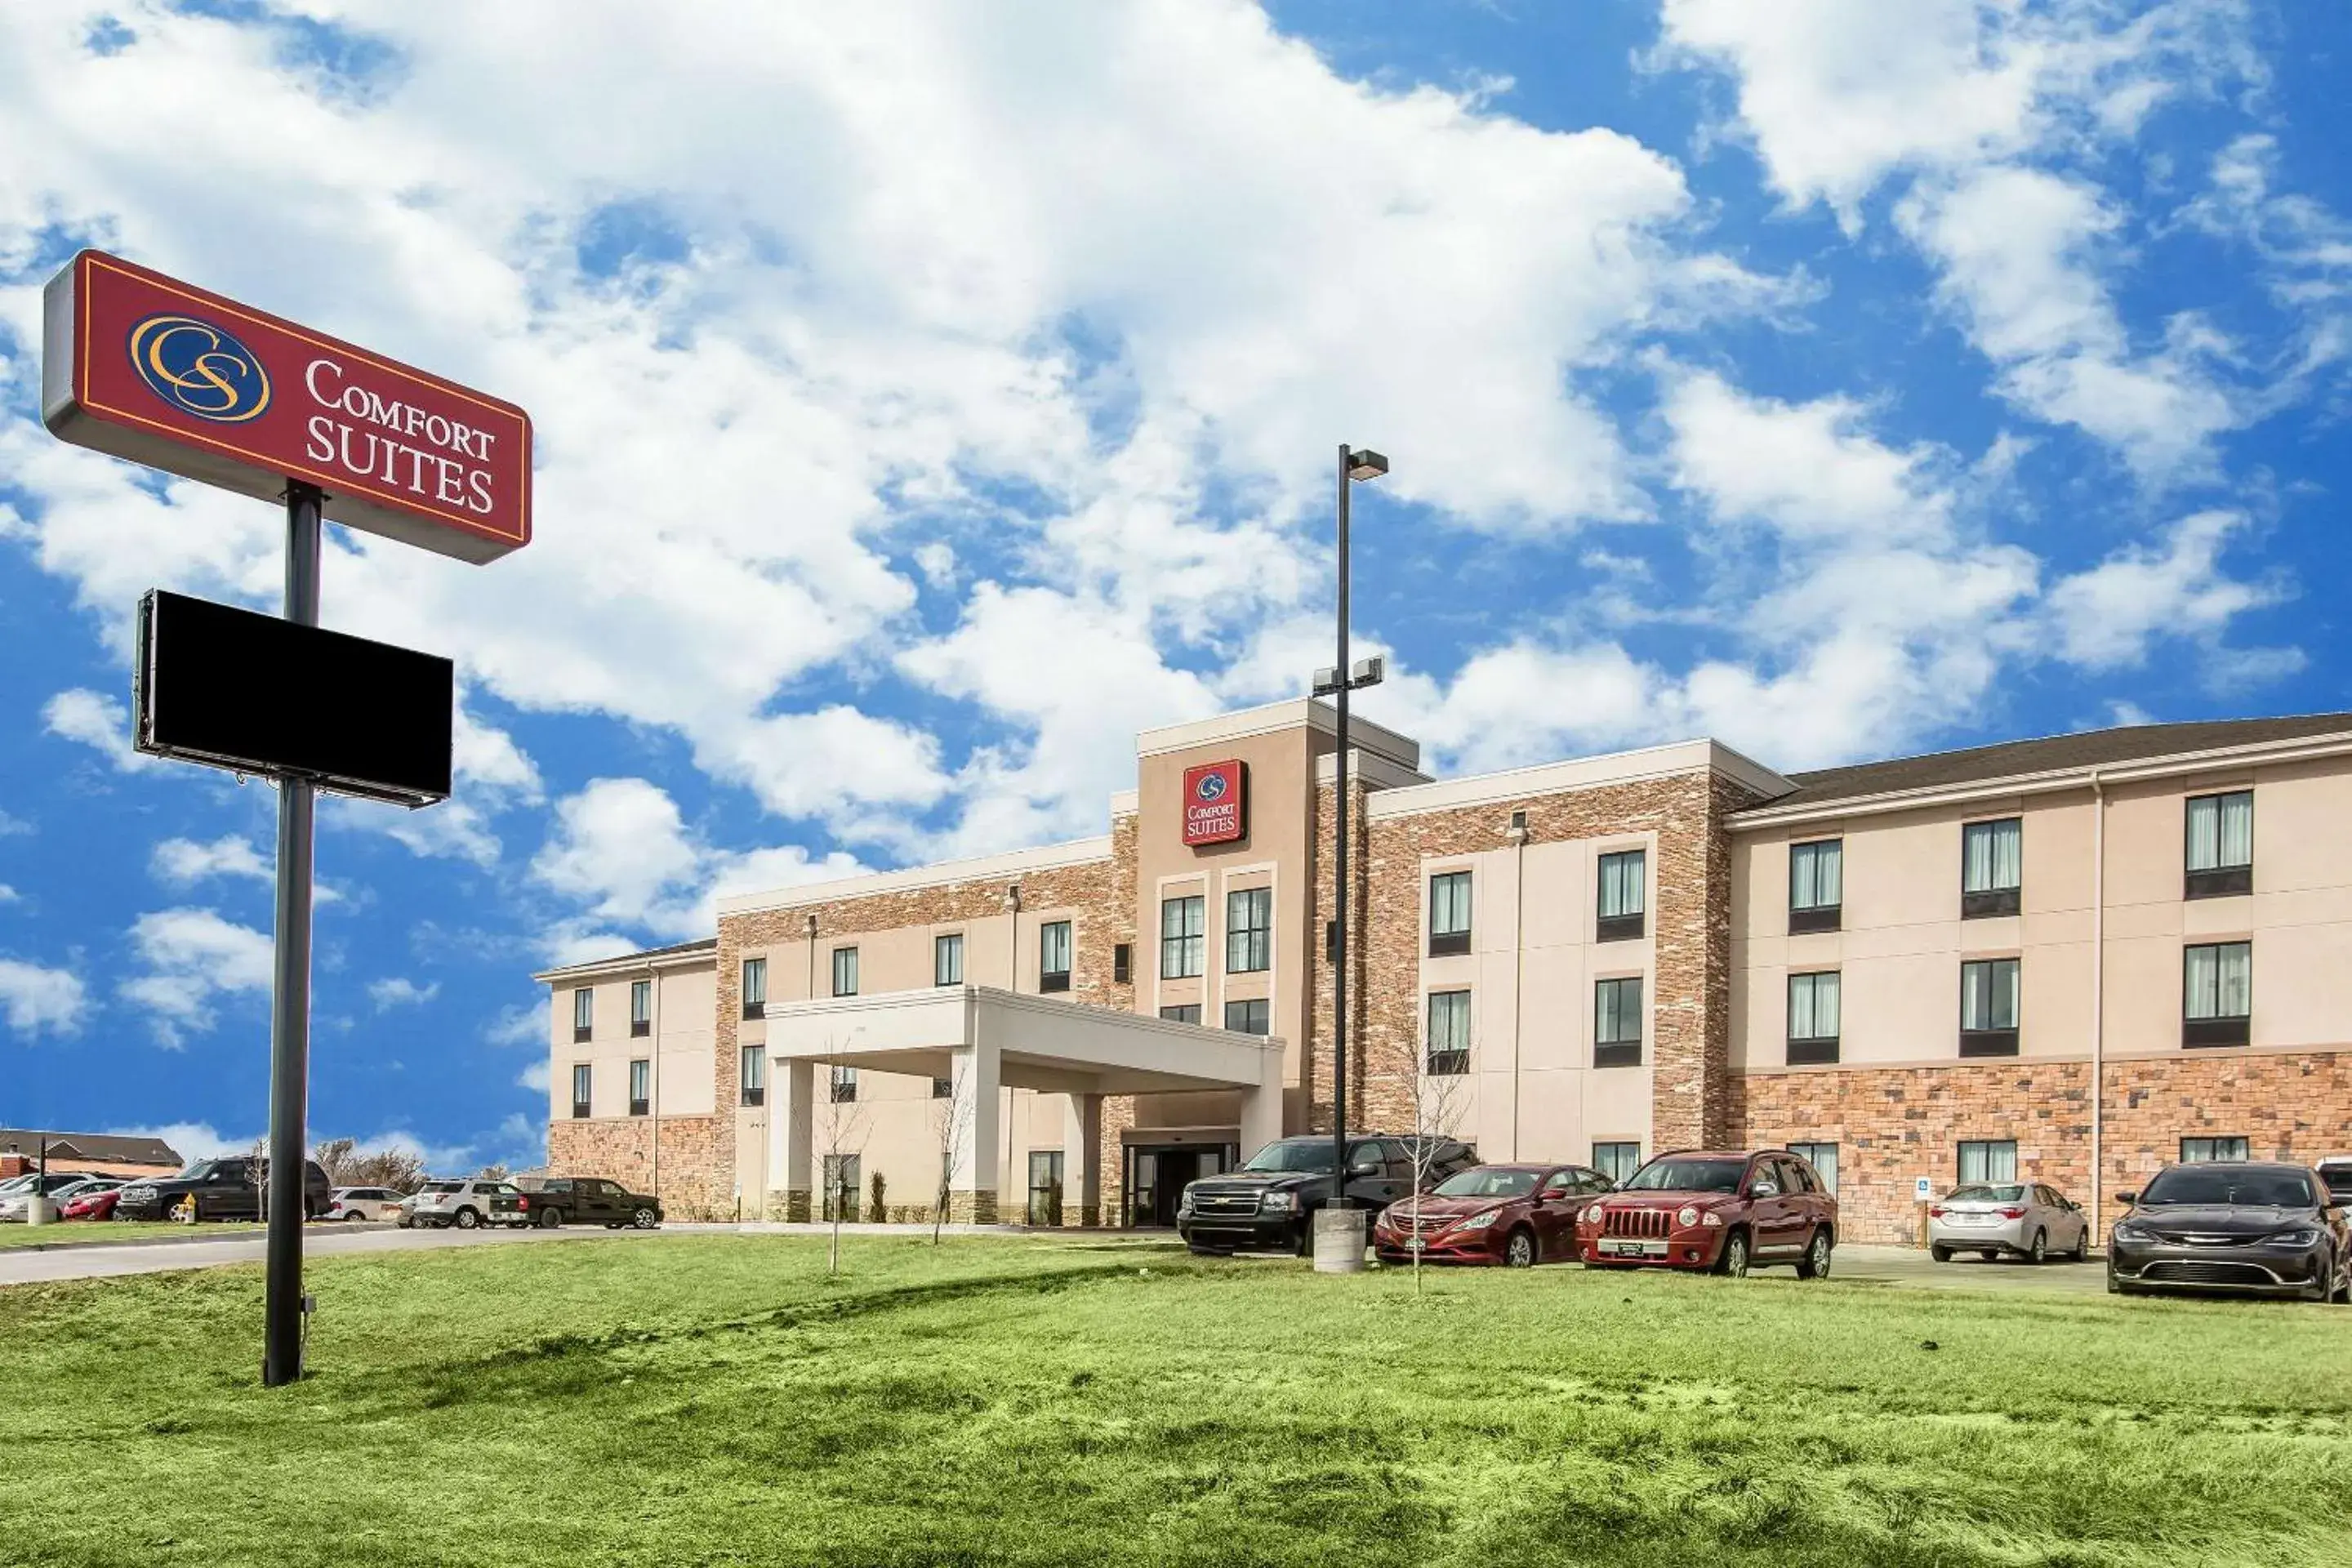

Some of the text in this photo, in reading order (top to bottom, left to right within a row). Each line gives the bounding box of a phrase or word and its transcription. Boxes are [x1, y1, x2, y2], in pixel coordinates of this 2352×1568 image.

[305, 360, 495, 462] COMFORT
[306, 416, 493, 514] SUITES
[1187, 804, 1235, 821] COMFORT
[1187, 817, 1235, 837] SUITES
